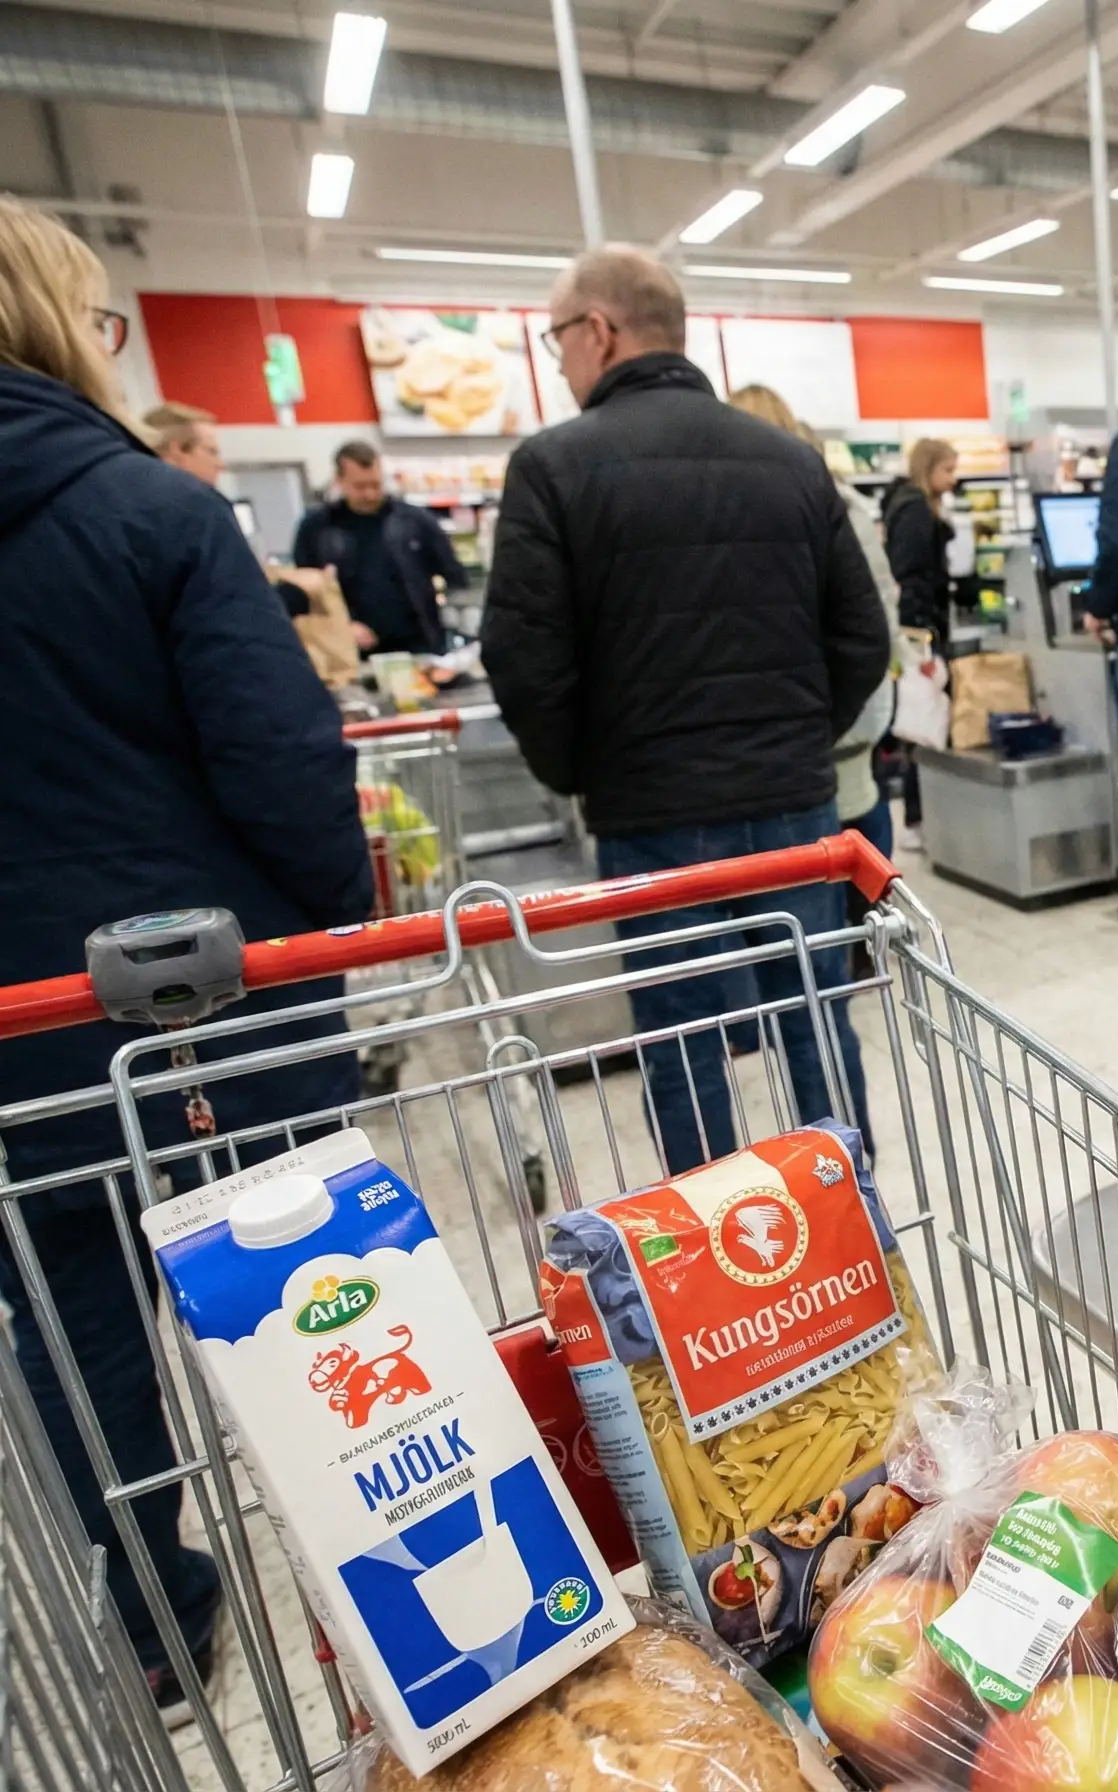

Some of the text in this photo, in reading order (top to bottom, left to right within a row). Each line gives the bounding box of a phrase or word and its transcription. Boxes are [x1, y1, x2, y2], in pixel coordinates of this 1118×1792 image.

[308, 1288, 368, 1329] Arla
[681, 1259, 878, 1371] Kungsörnen
[353, 1417, 477, 1513] MJÖLK
